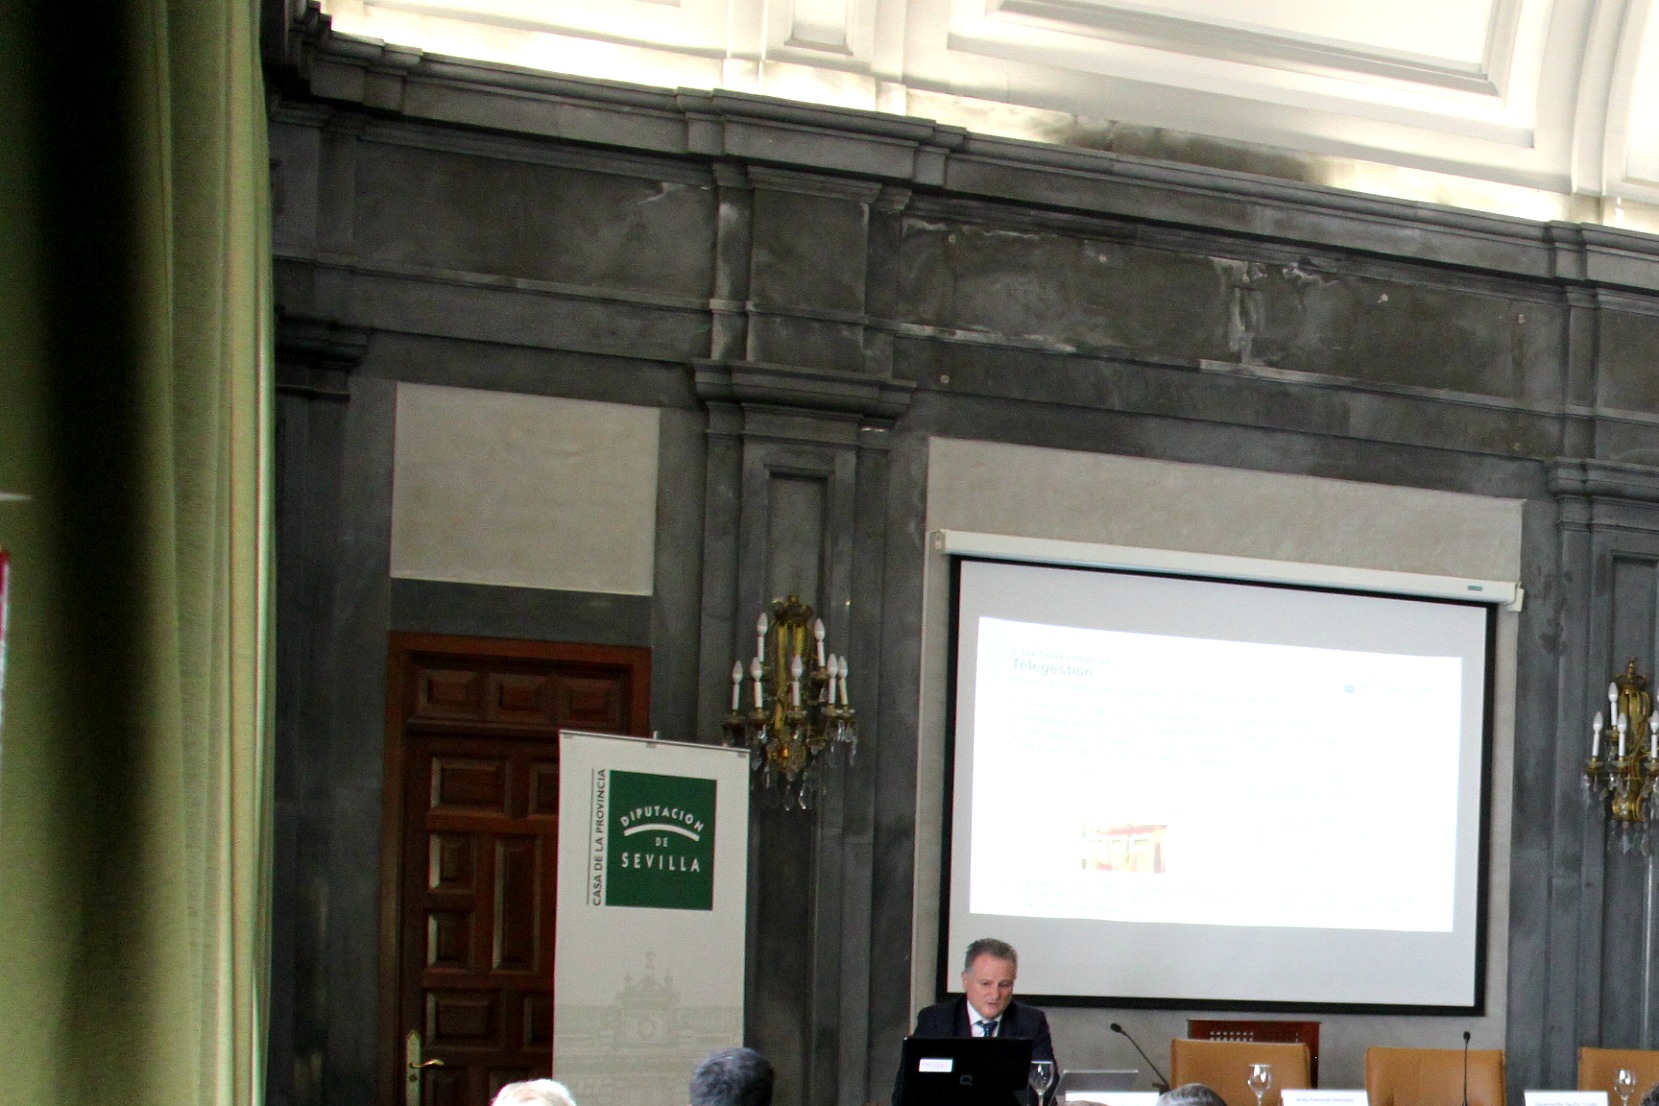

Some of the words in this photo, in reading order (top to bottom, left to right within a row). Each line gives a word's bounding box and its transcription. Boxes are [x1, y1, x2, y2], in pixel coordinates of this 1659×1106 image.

[596, 768, 606, 834] PROVINCIA
[620, 805, 704, 832] DIPUTACION
[596, 837, 604, 854] LA
[655, 837, 668, 847] DE
[594, 857, 603, 870] DE
[621, 852, 700, 873] SEVILLA
[592, 874, 602, 906] CASA
